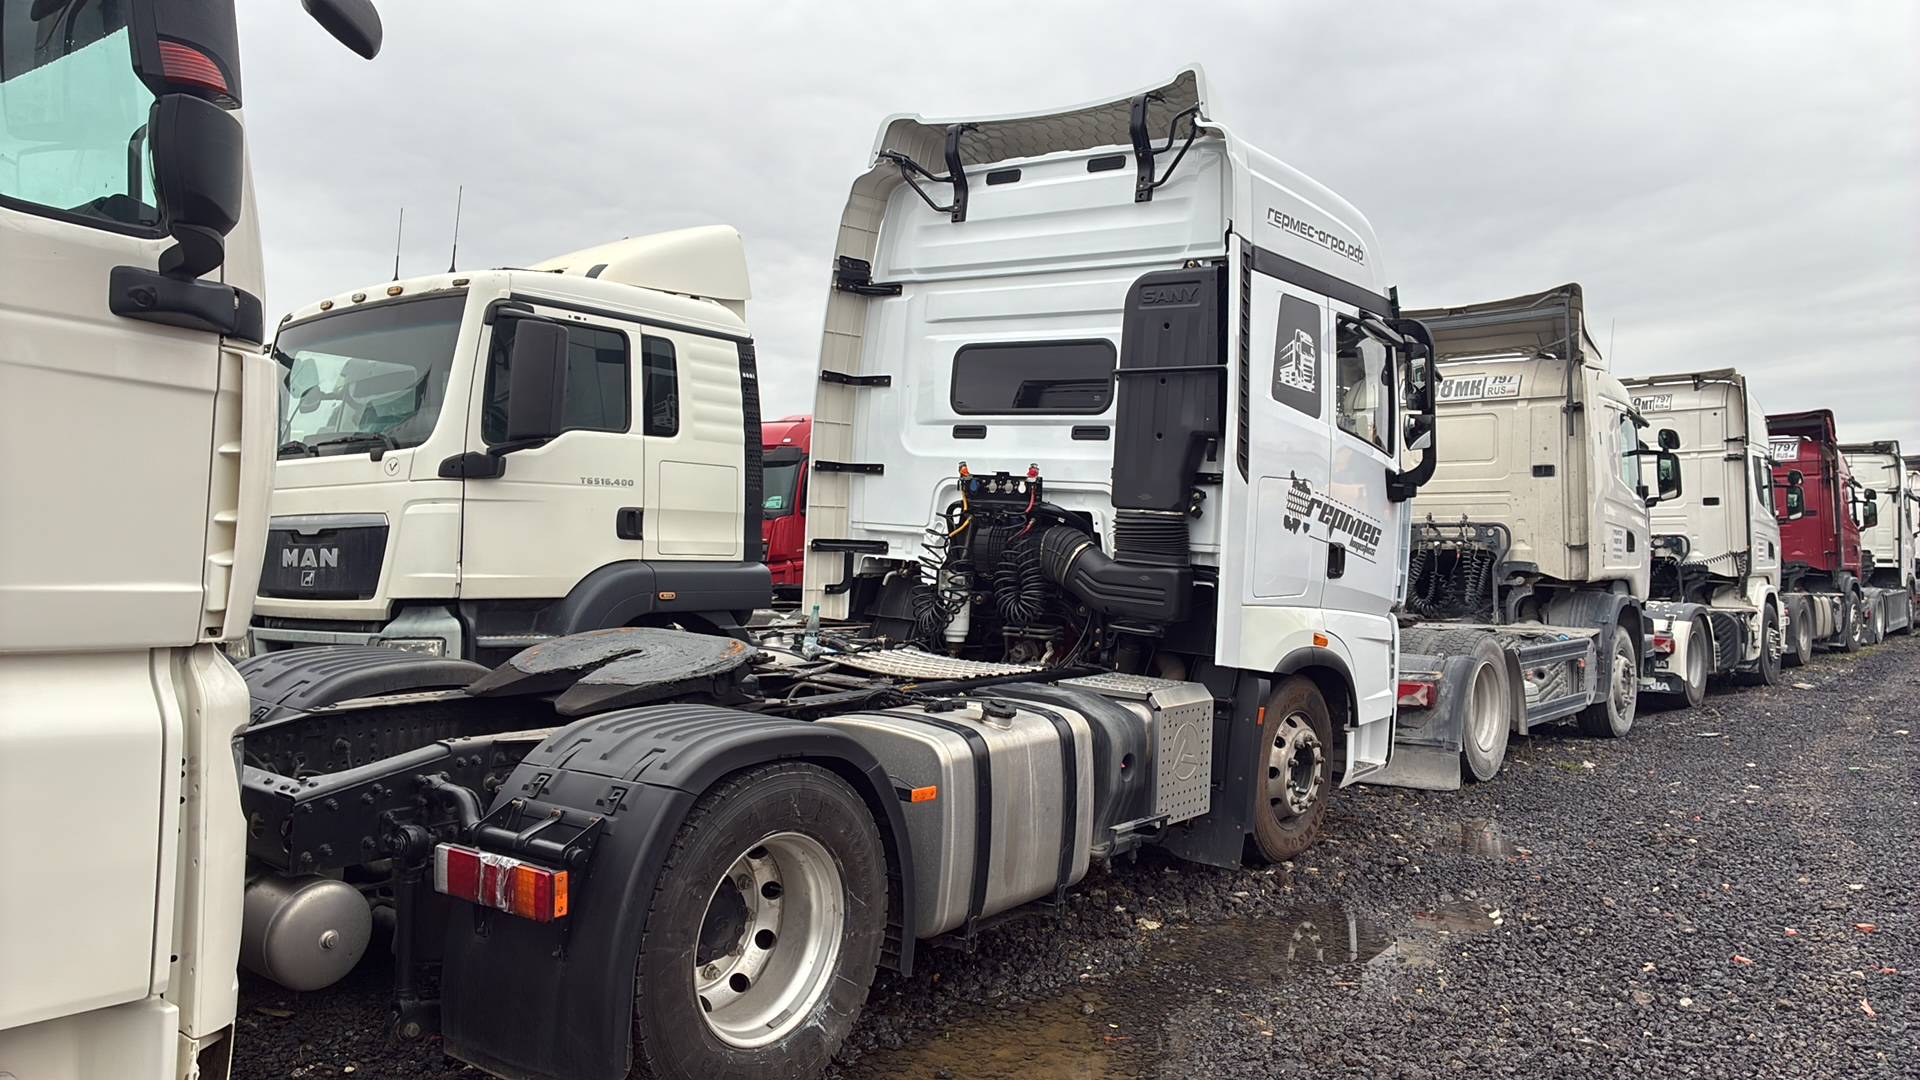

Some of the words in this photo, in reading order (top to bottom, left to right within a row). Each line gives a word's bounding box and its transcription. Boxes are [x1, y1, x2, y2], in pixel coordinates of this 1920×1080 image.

[1143, 287, 1200, 304] SANY
[1487, 386, 1506, 395] RUS
[1777, 443, 1797, 451] 797
[282, 548, 338, 568] MAN
